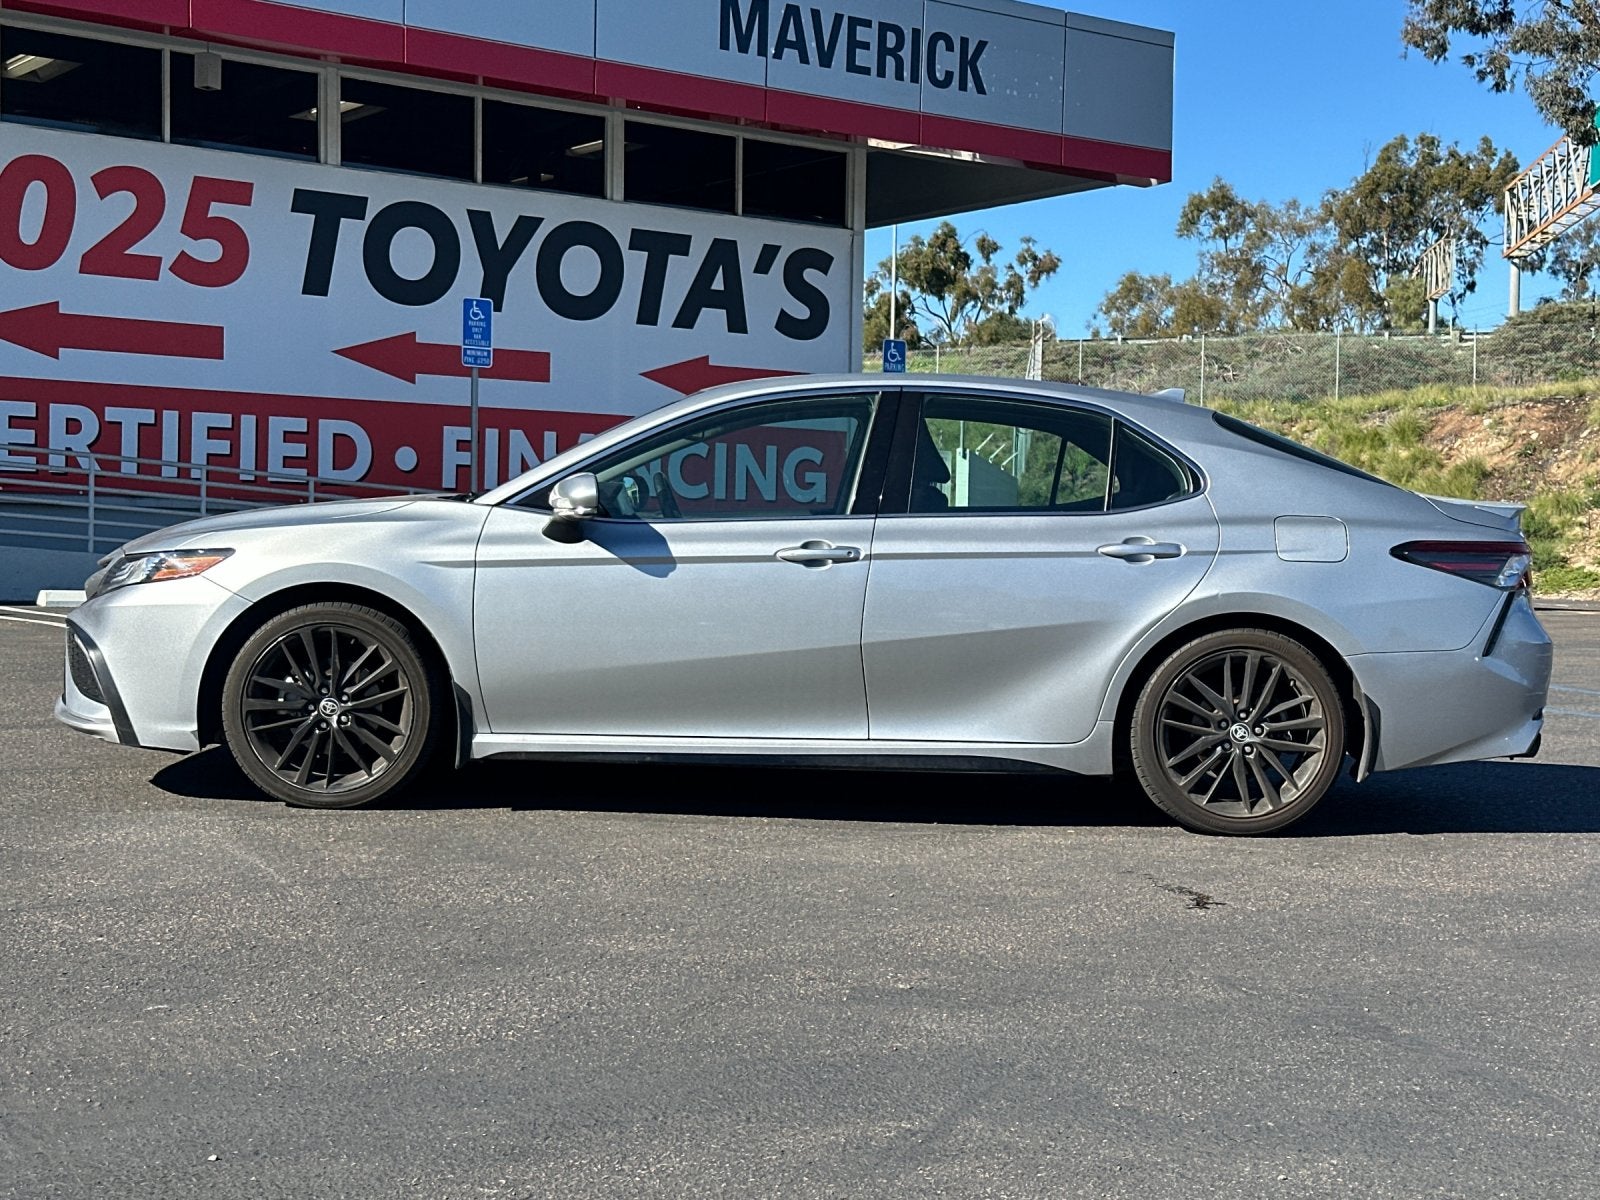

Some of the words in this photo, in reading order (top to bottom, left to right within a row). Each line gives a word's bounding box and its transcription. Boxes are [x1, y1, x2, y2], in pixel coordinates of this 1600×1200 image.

[719, 0, 989, 96] MAVERICK
[0, 154, 254, 288] 025
[290, 188, 834, 341] TOYOTA'S
[0, 400, 373, 483] ERTIFIED
[442, 425, 827, 503] FINCING
